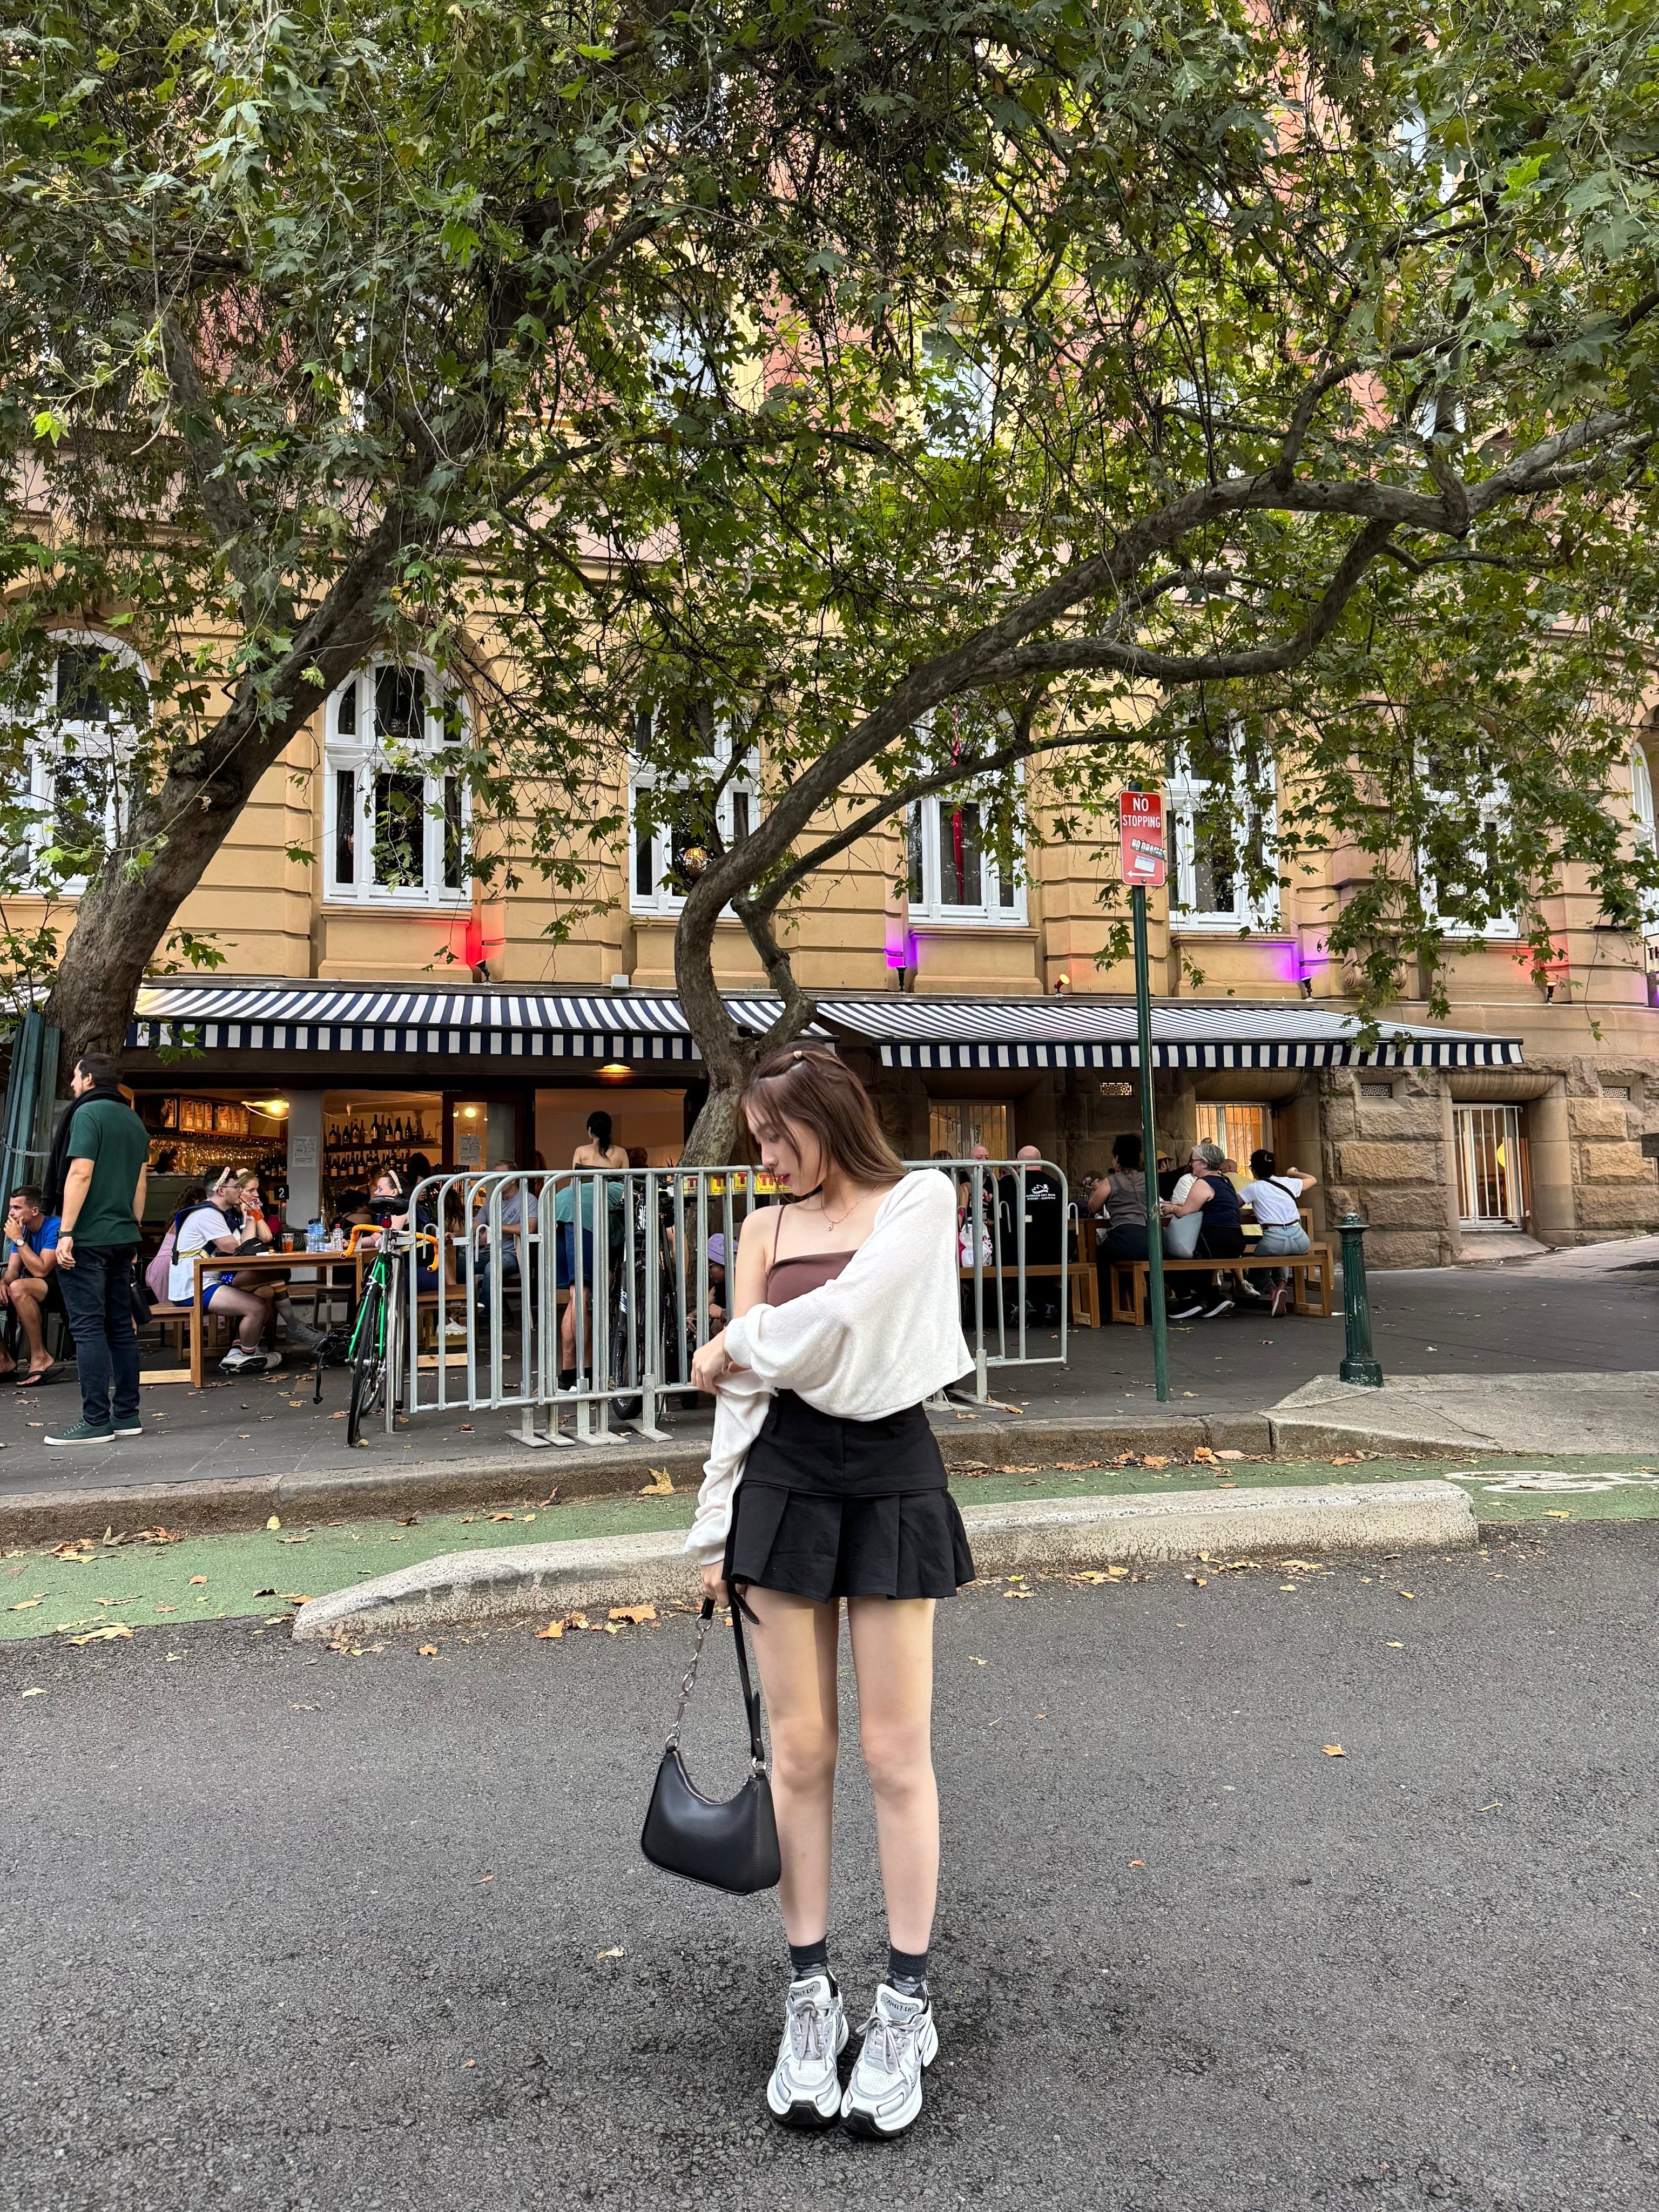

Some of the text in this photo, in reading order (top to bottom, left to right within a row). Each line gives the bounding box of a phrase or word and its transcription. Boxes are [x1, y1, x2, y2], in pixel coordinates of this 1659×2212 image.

[1133, 797, 1149, 812] NO
[1122, 814, 1161, 828] STOPPING
[1131, 838, 1141, 851] NO
[279, 1188, 285, 1198] 2
